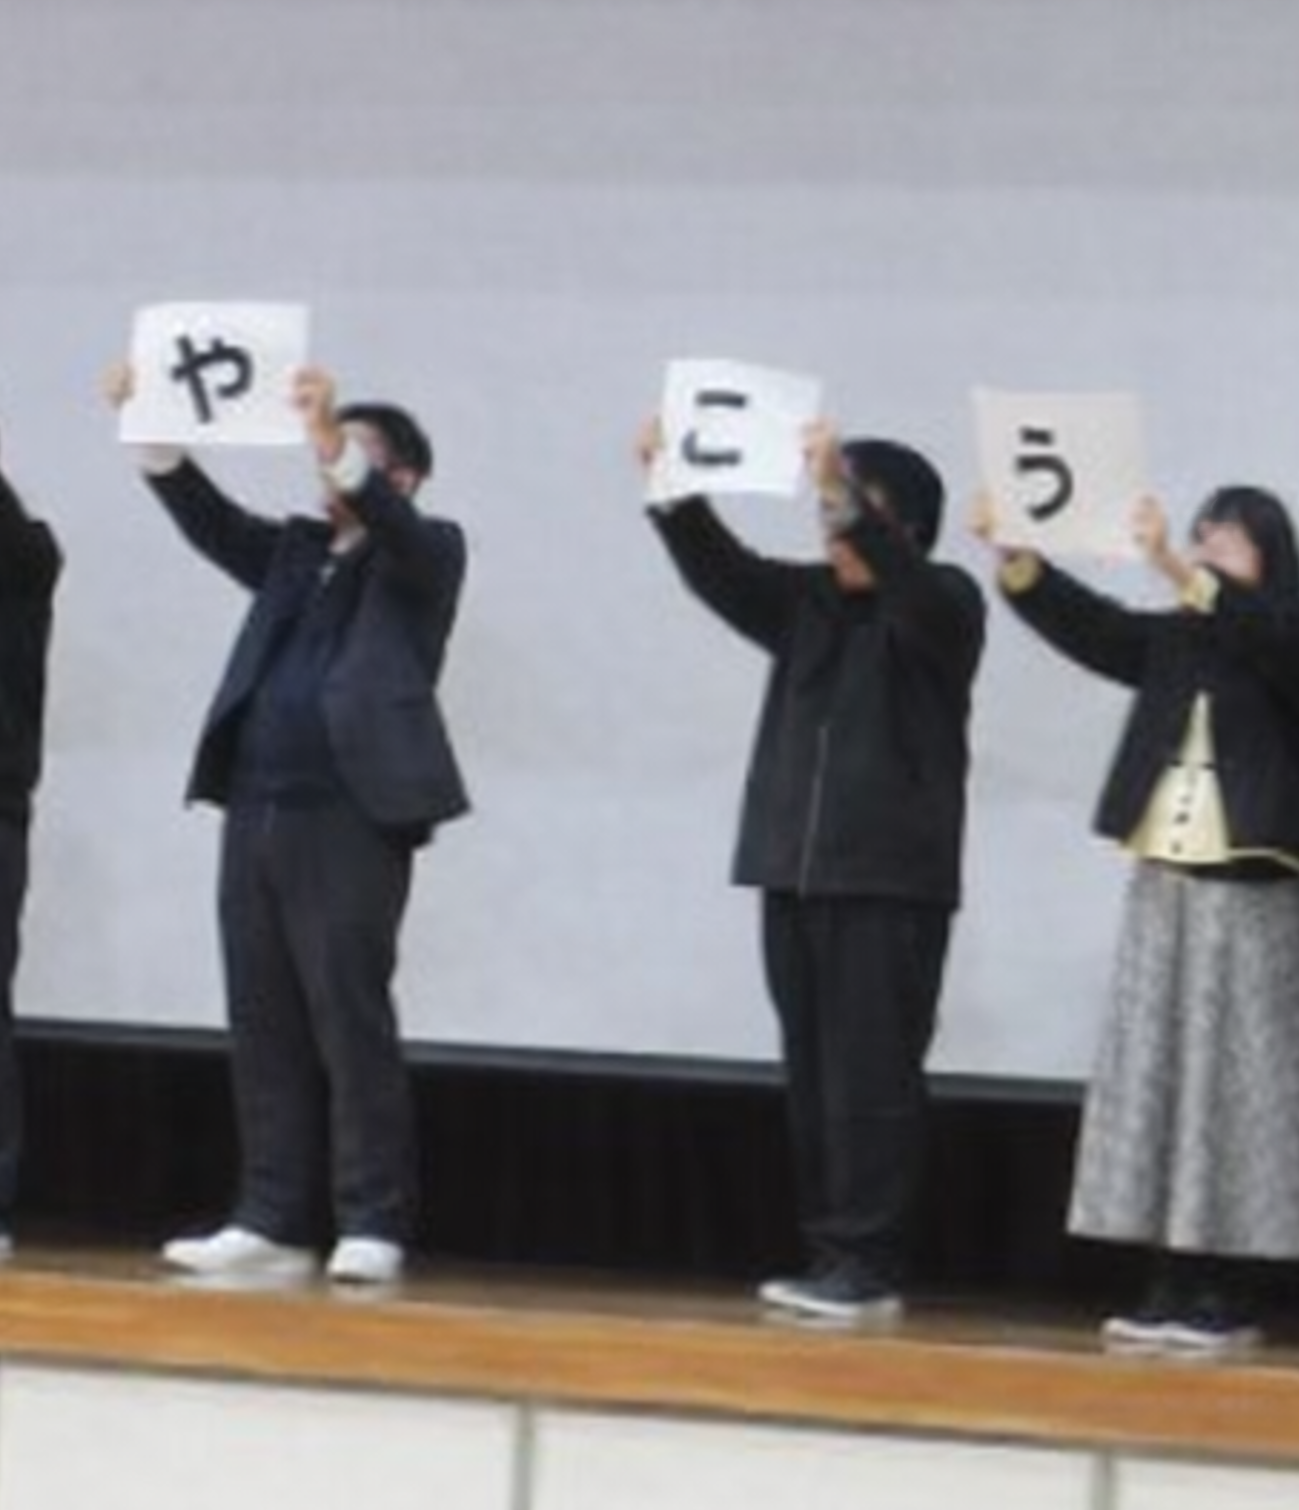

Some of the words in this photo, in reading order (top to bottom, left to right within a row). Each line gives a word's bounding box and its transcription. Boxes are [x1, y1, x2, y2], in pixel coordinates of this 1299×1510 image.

[170, 334, 253, 423] や
[684, 392, 747, 466] こ
[1014, 428, 1074, 523] う
